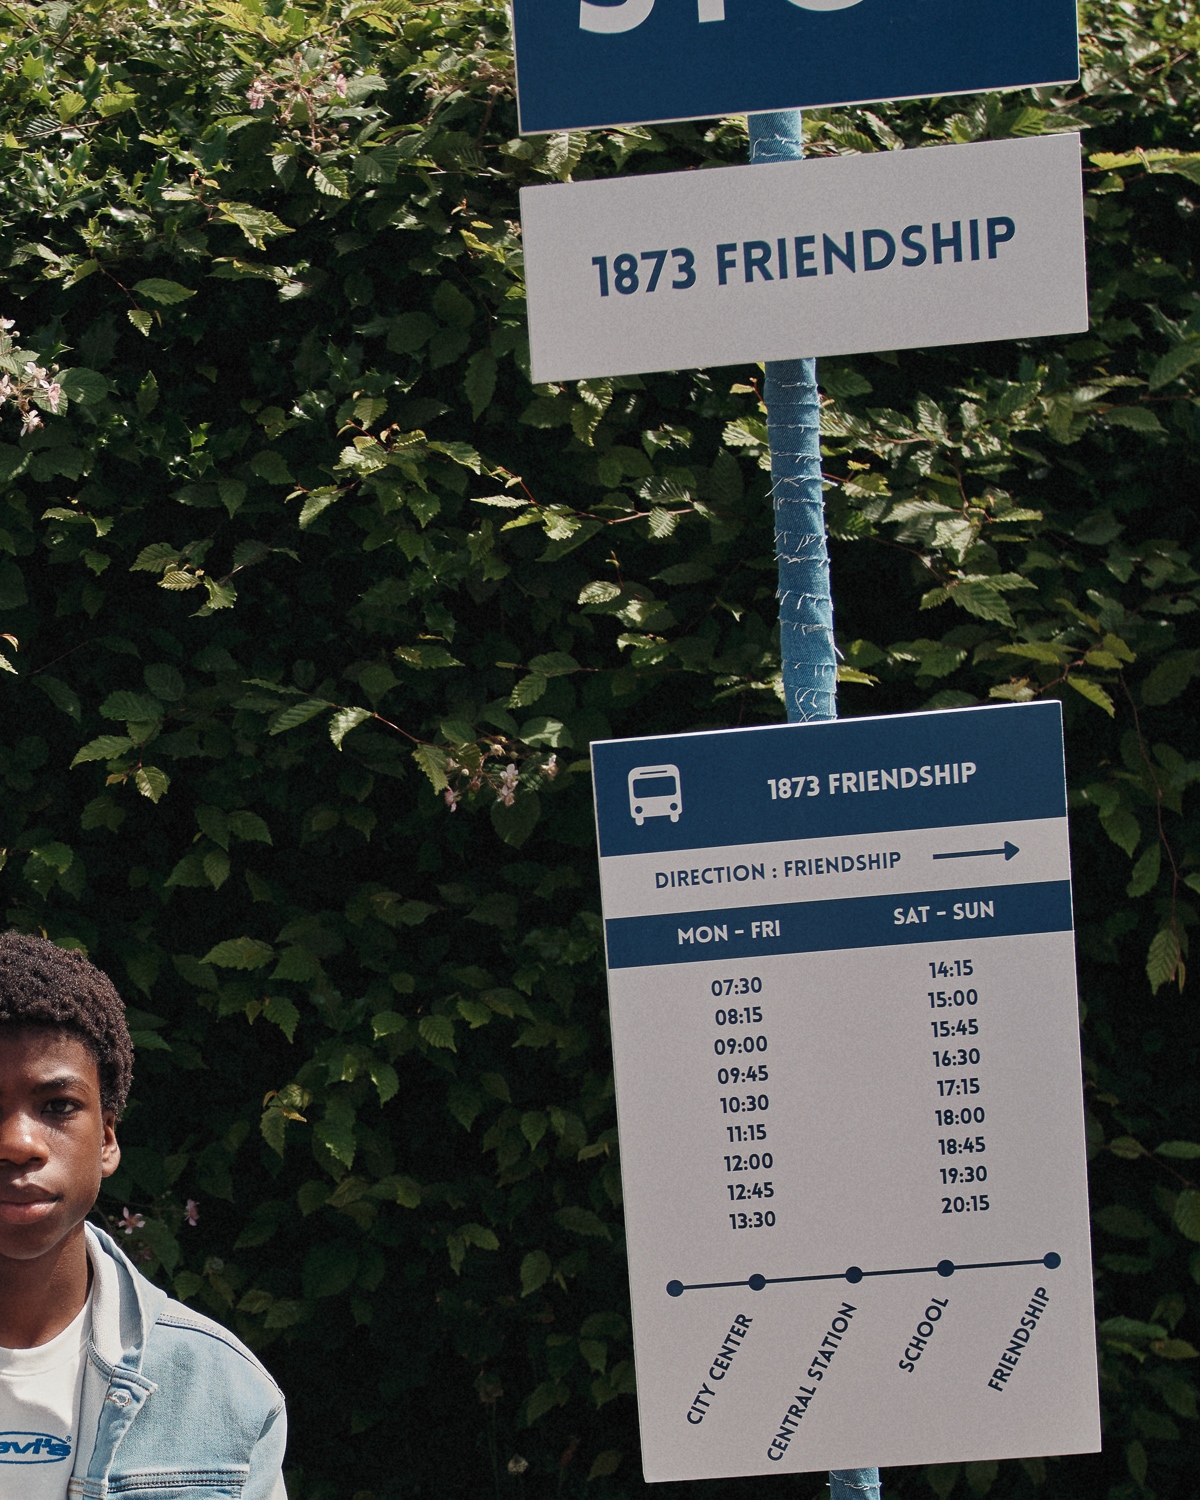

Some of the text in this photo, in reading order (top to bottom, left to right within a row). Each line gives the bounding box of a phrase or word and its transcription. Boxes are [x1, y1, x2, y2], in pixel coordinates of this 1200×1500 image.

[591, 216, 1016, 297] 1873 FRIENDSHIP
[767, 761, 977, 800] 1873 FRIENDSHIP
[655, 862, 765, 889] DIRECTION
[783, 851, 901, 878] FRIENDSHIP
[893, 905, 931, 925] SAT
[953, 900, 995, 920] SUN
[677, 924, 729, 945] MON
[751, 919, 781, 939] FRI
[928, 959, 974, 979] 14:15
[711, 976, 763, 997] 07:30
[927, 988, 978, 1009] 15:00
[715, 1005, 763, 1026] 08:15
[930, 1018, 979, 1038] 15:45
[714, 1035, 768, 1056] 09:00
[932, 1047, 981, 1068] 16:30
[717, 1064, 769, 1085] 09:45
[936, 1077, 980, 1097] 17:15
[719, 1093, 770, 1114] 10:30
[934, 1106, 985, 1127] 18:00
[726, 1123, 767, 1143] 11:15
[937, 1135, 986, 1156] 18:45
[723, 1152, 774, 1172] 12:00
[939, 1165, 988, 1185] 19:30
[726, 1181, 775, 1201] 12:45
[941, 1194, 990, 1214] 20:15
[728, 1210, 776, 1230] 13:30
[898, 1297, 949, 1374] SCHOOL
[987, 1286, 1050, 1392] FRIENDSHIP
[686, 1313, 754, 1425] CITY CENTER
[767, 1301, 858, 1461] CENTRAL STATION
